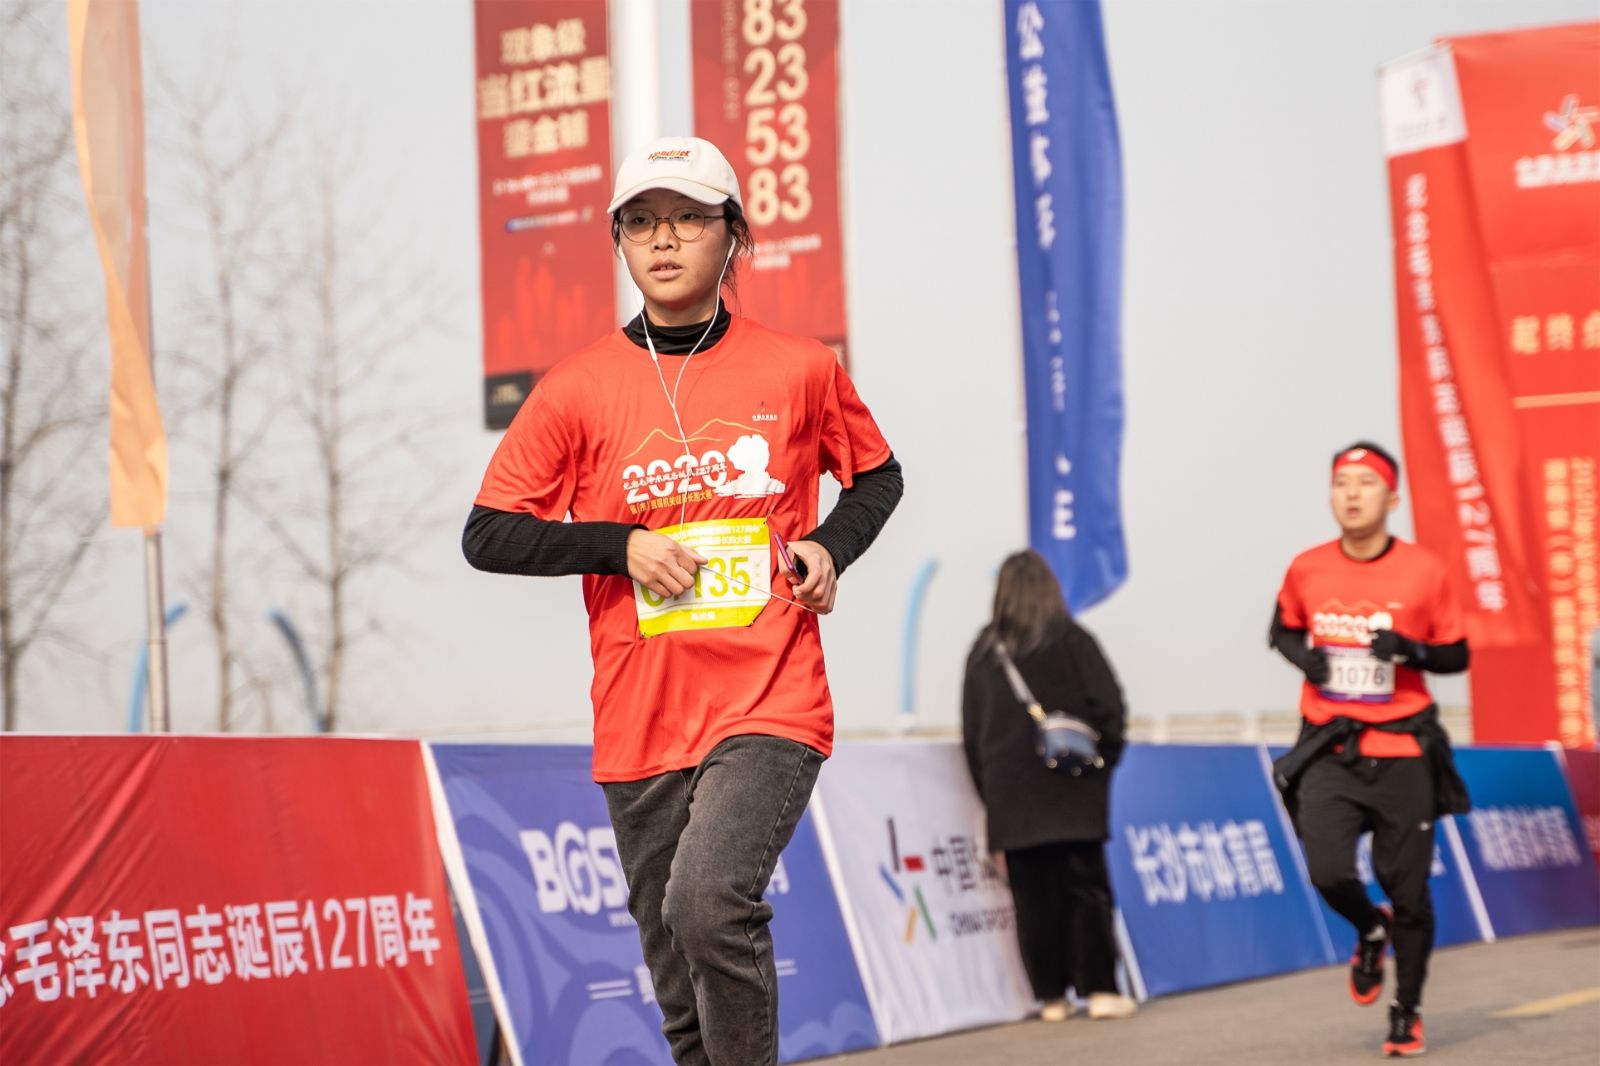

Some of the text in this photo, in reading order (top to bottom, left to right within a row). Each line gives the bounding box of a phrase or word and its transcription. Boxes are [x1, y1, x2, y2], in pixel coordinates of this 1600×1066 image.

[742, 0, 808, 45] 83
[743, 42, 809, 106] 23
[746, 102, 811, 166] 53
[748, 163, 812, 227] 83
[622, 450, 729, 504] 2020
[641, 556, 751, 607] 135
[1328, 665, 1386, 687] 1076
[1126, 820, 1285, 906] 长沙市体育局
